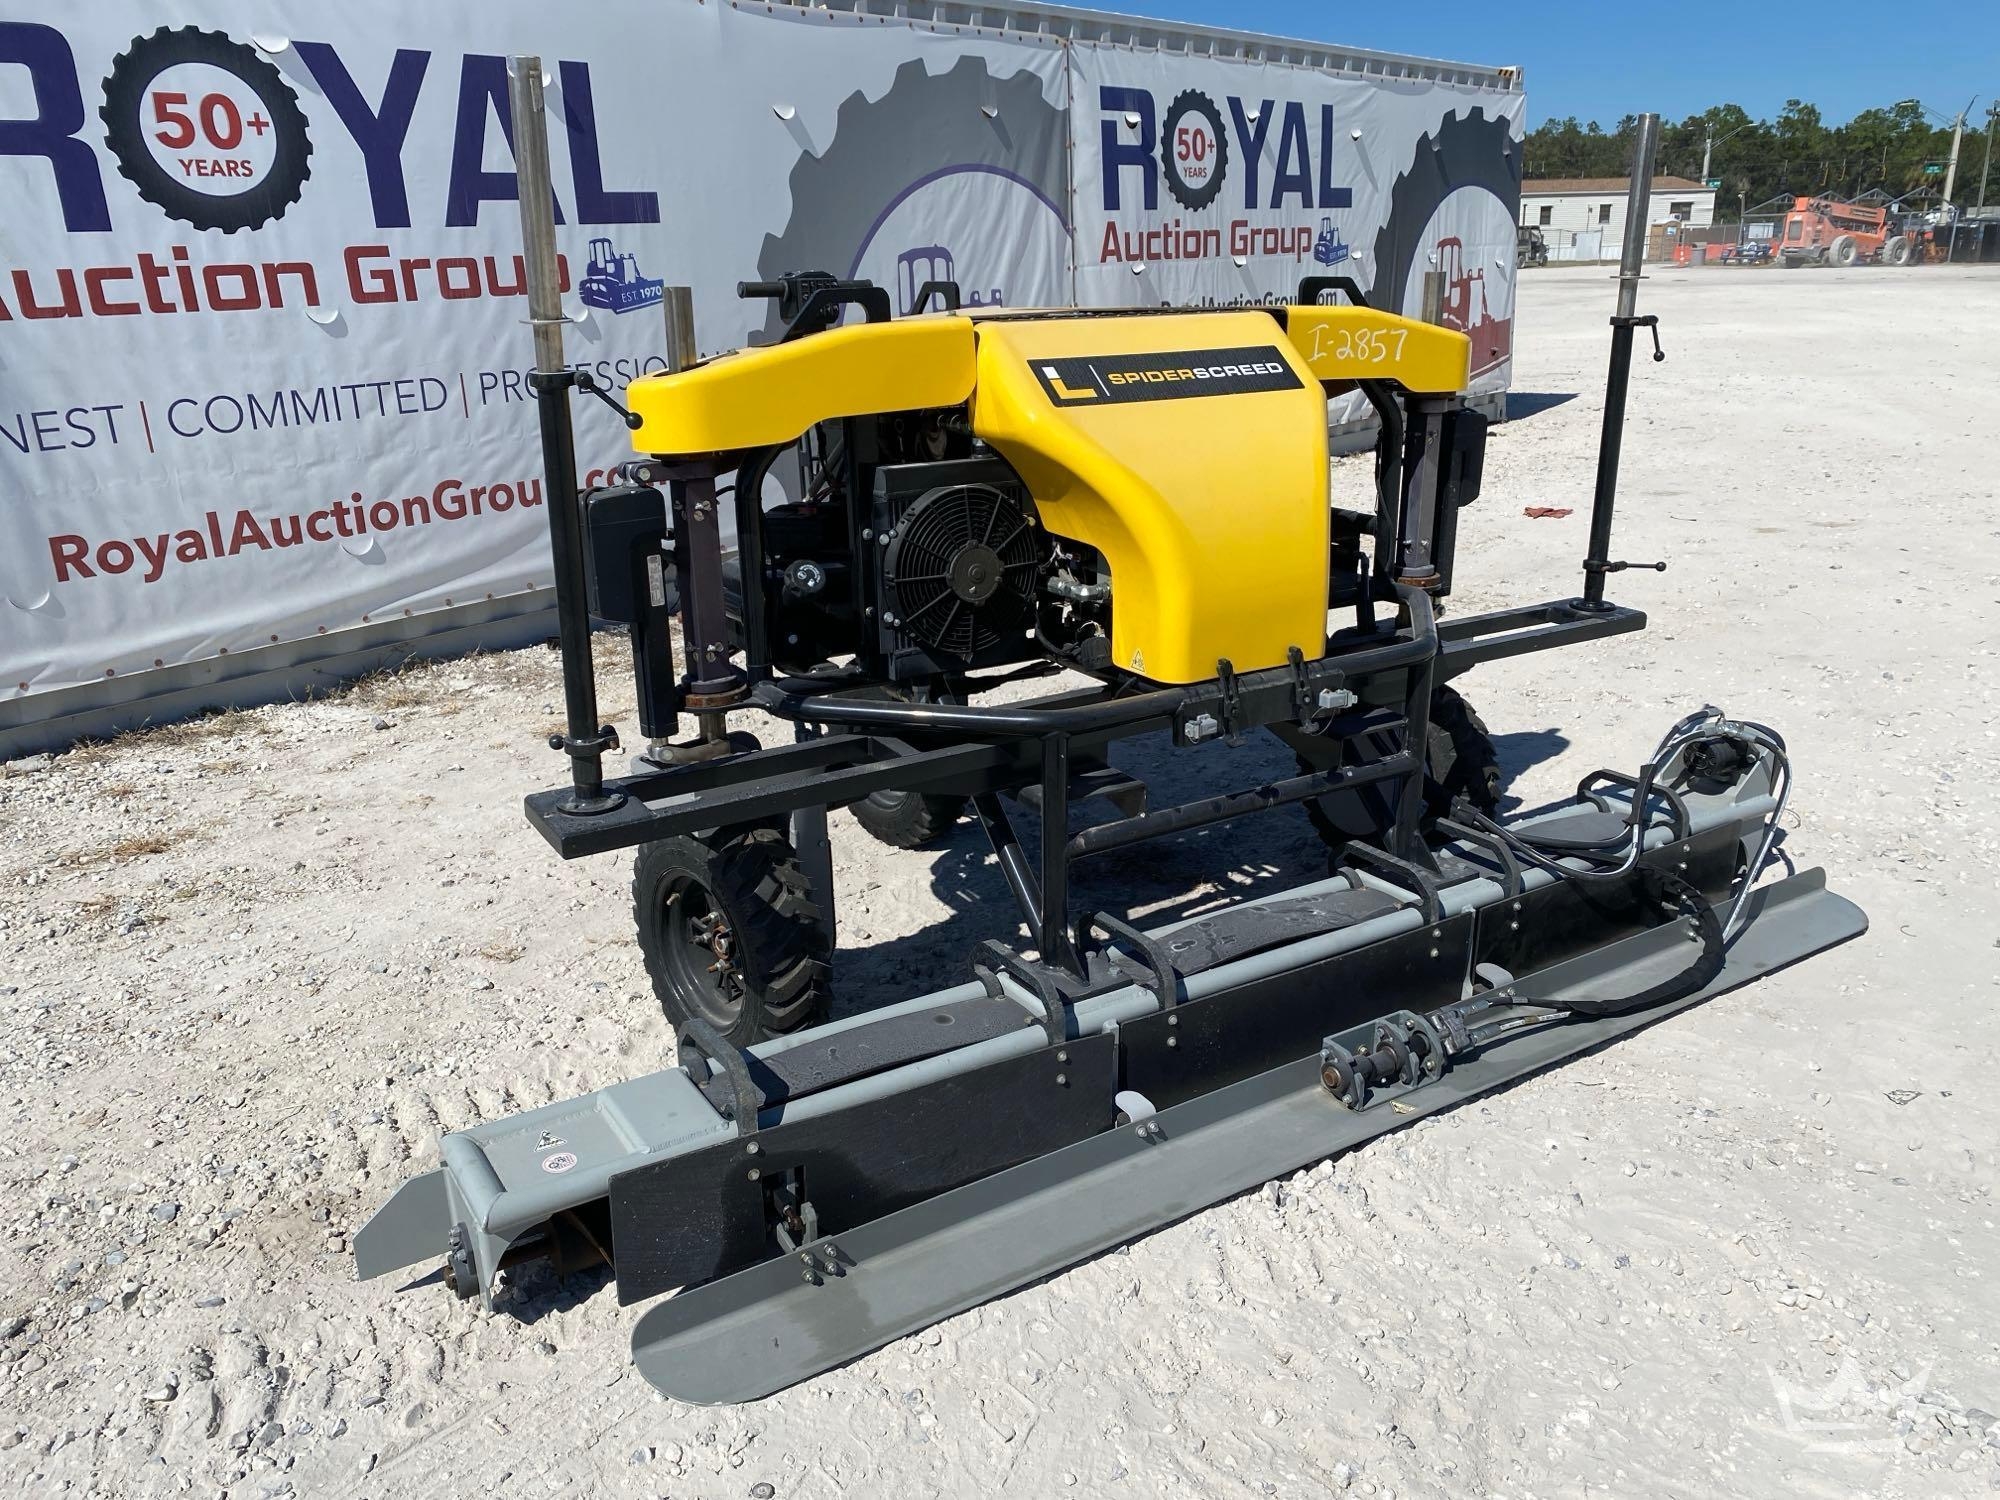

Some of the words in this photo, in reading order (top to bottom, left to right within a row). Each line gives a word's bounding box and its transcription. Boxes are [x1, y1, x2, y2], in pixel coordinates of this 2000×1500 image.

[152, 92, 270, 150] 50+
[1100, 86, 1352, 211] ROYAL
[1177, 127, 1215, 162] 50+
[178, 158, 254, 179] YEARS
[1183, 166, 1207, 178] YEARS
[1100, 219, 1221, 264] Auction
[1230, 219, 1312, 265] Group
[0, 245, 322, 320] uction
[621, 290, 639, 303] EST.
[640, 285, 662, 299] 1970
[1307, 323, 1408, 362] I-2857
[1106, 361, 1284, 385] SPIDERSCREED
[167, 376, 448, 438] COMMITTED
